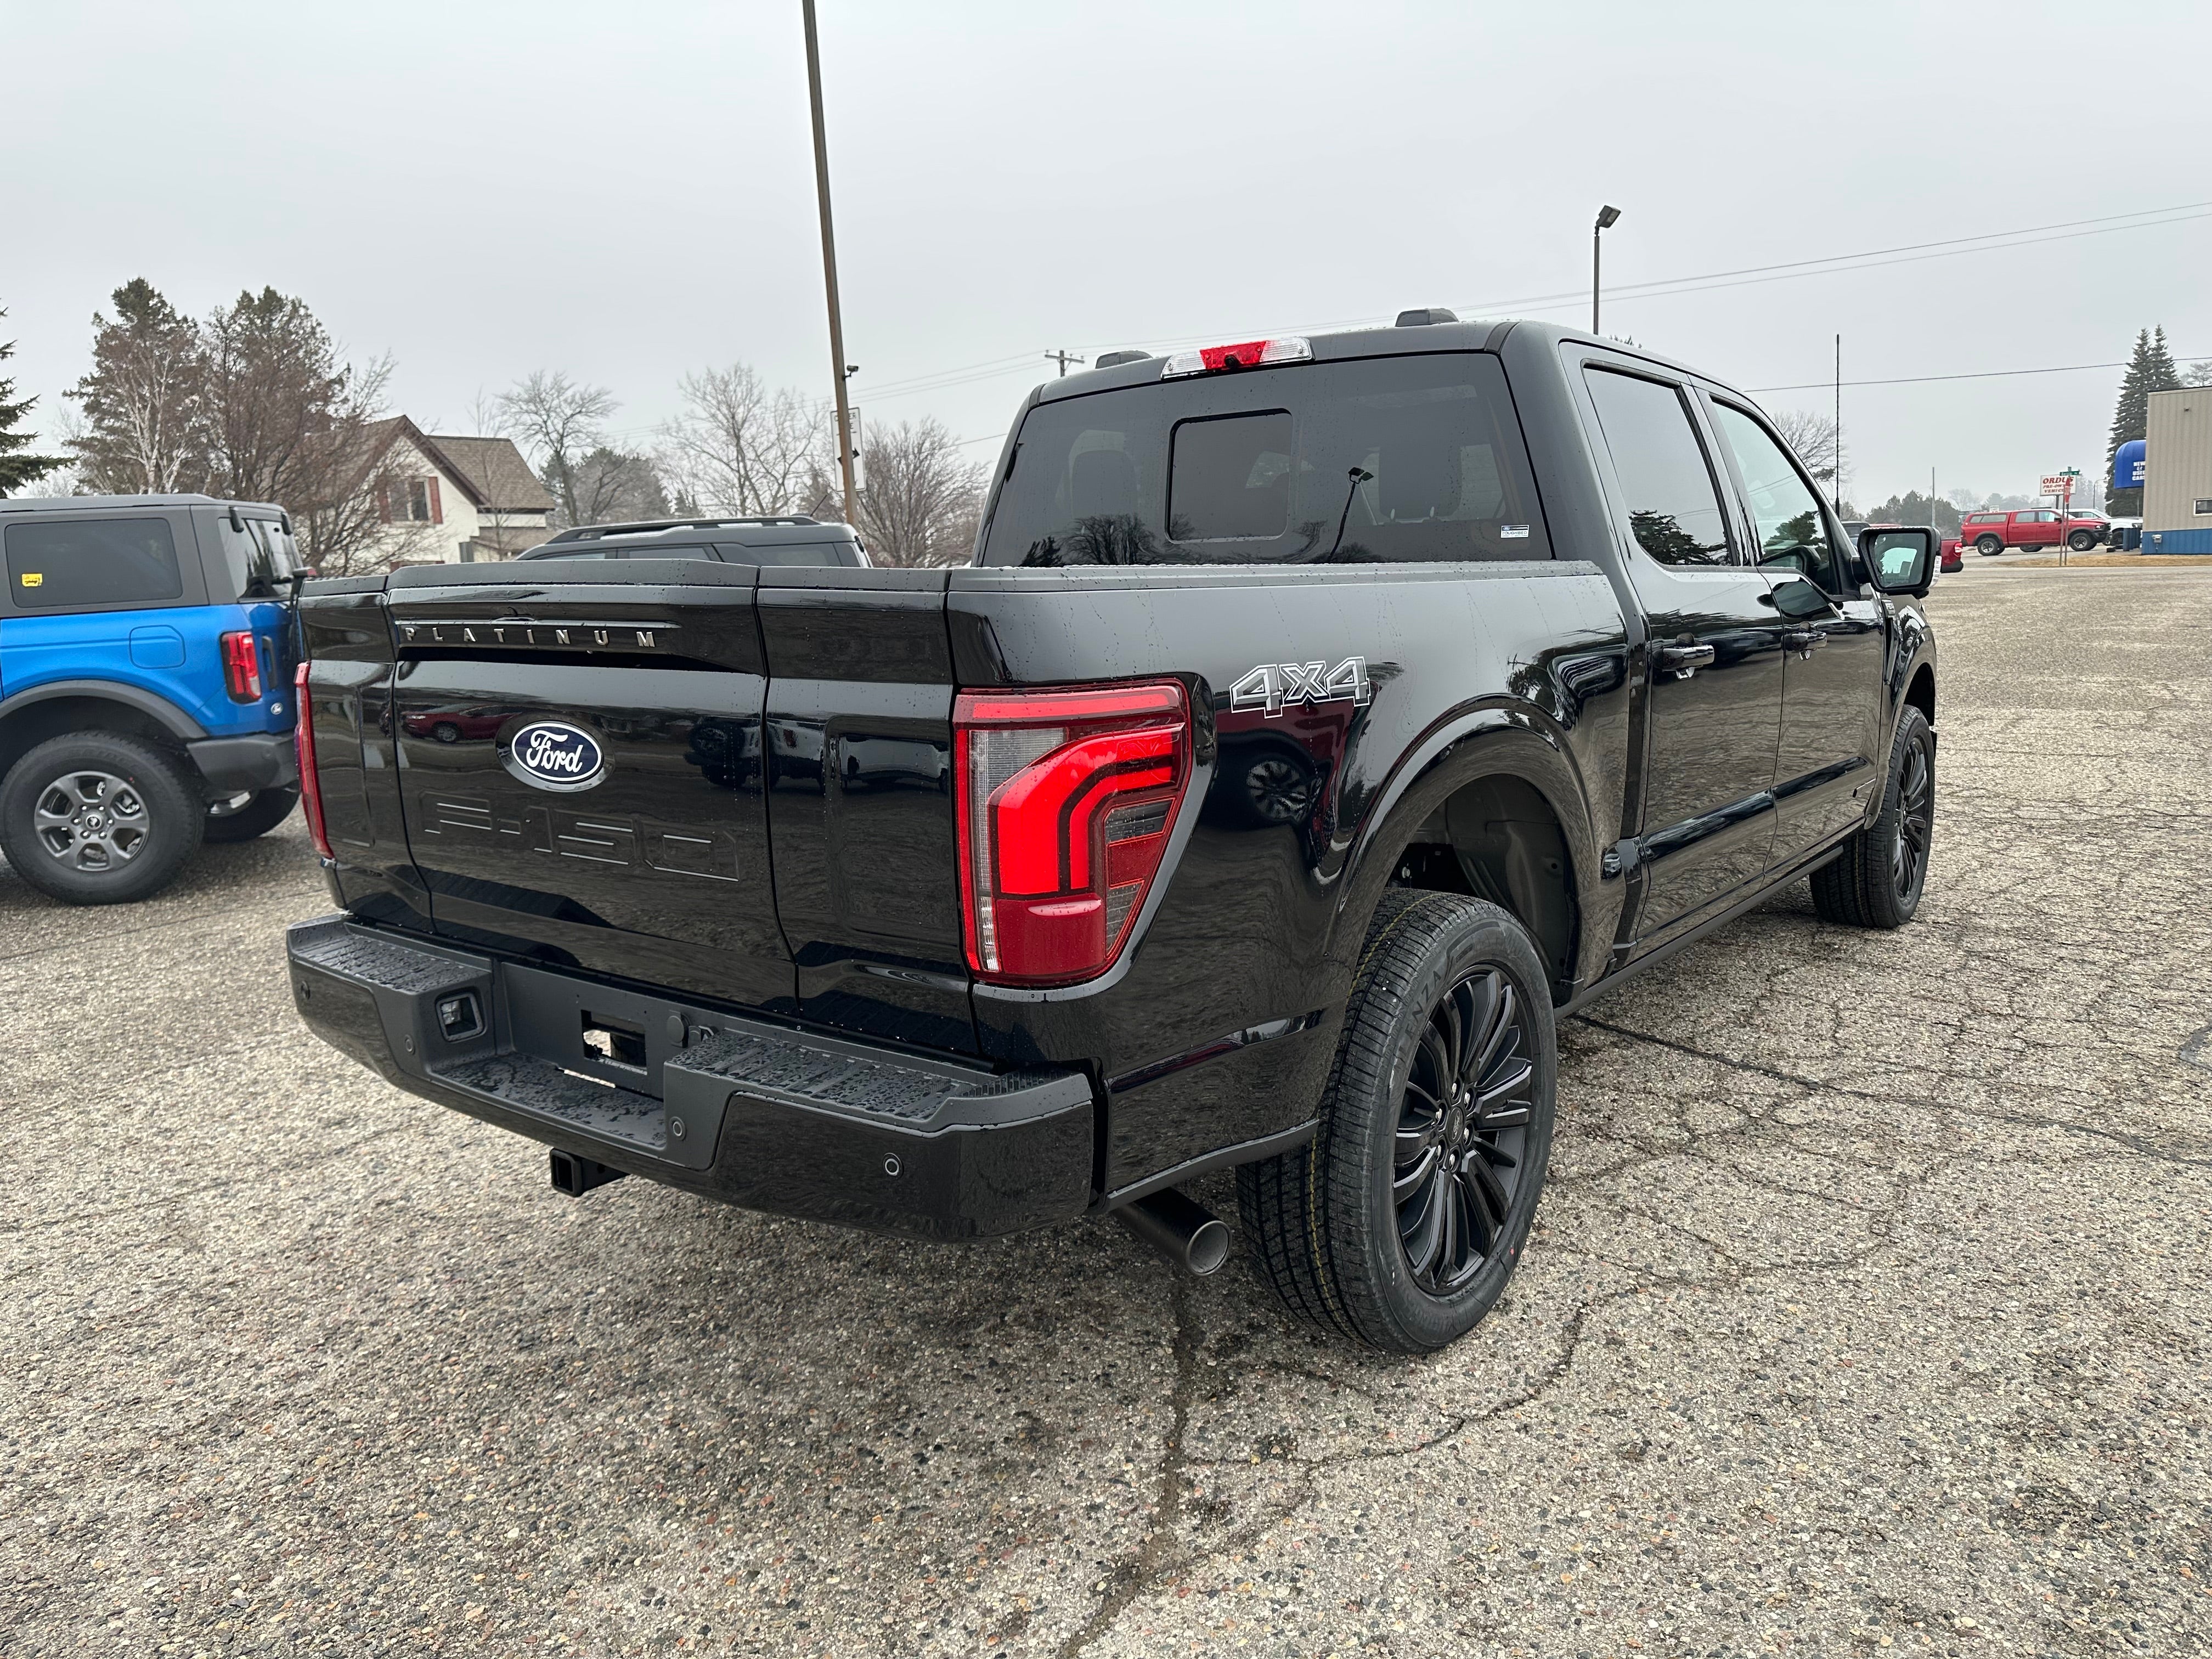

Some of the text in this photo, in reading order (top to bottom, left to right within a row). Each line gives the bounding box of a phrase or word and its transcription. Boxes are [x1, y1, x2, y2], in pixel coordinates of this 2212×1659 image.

[405, 627, 656, 648] PLATINUM
[526, 729, 584, 773] Ford
[418, 790, 740, 882] F-150
